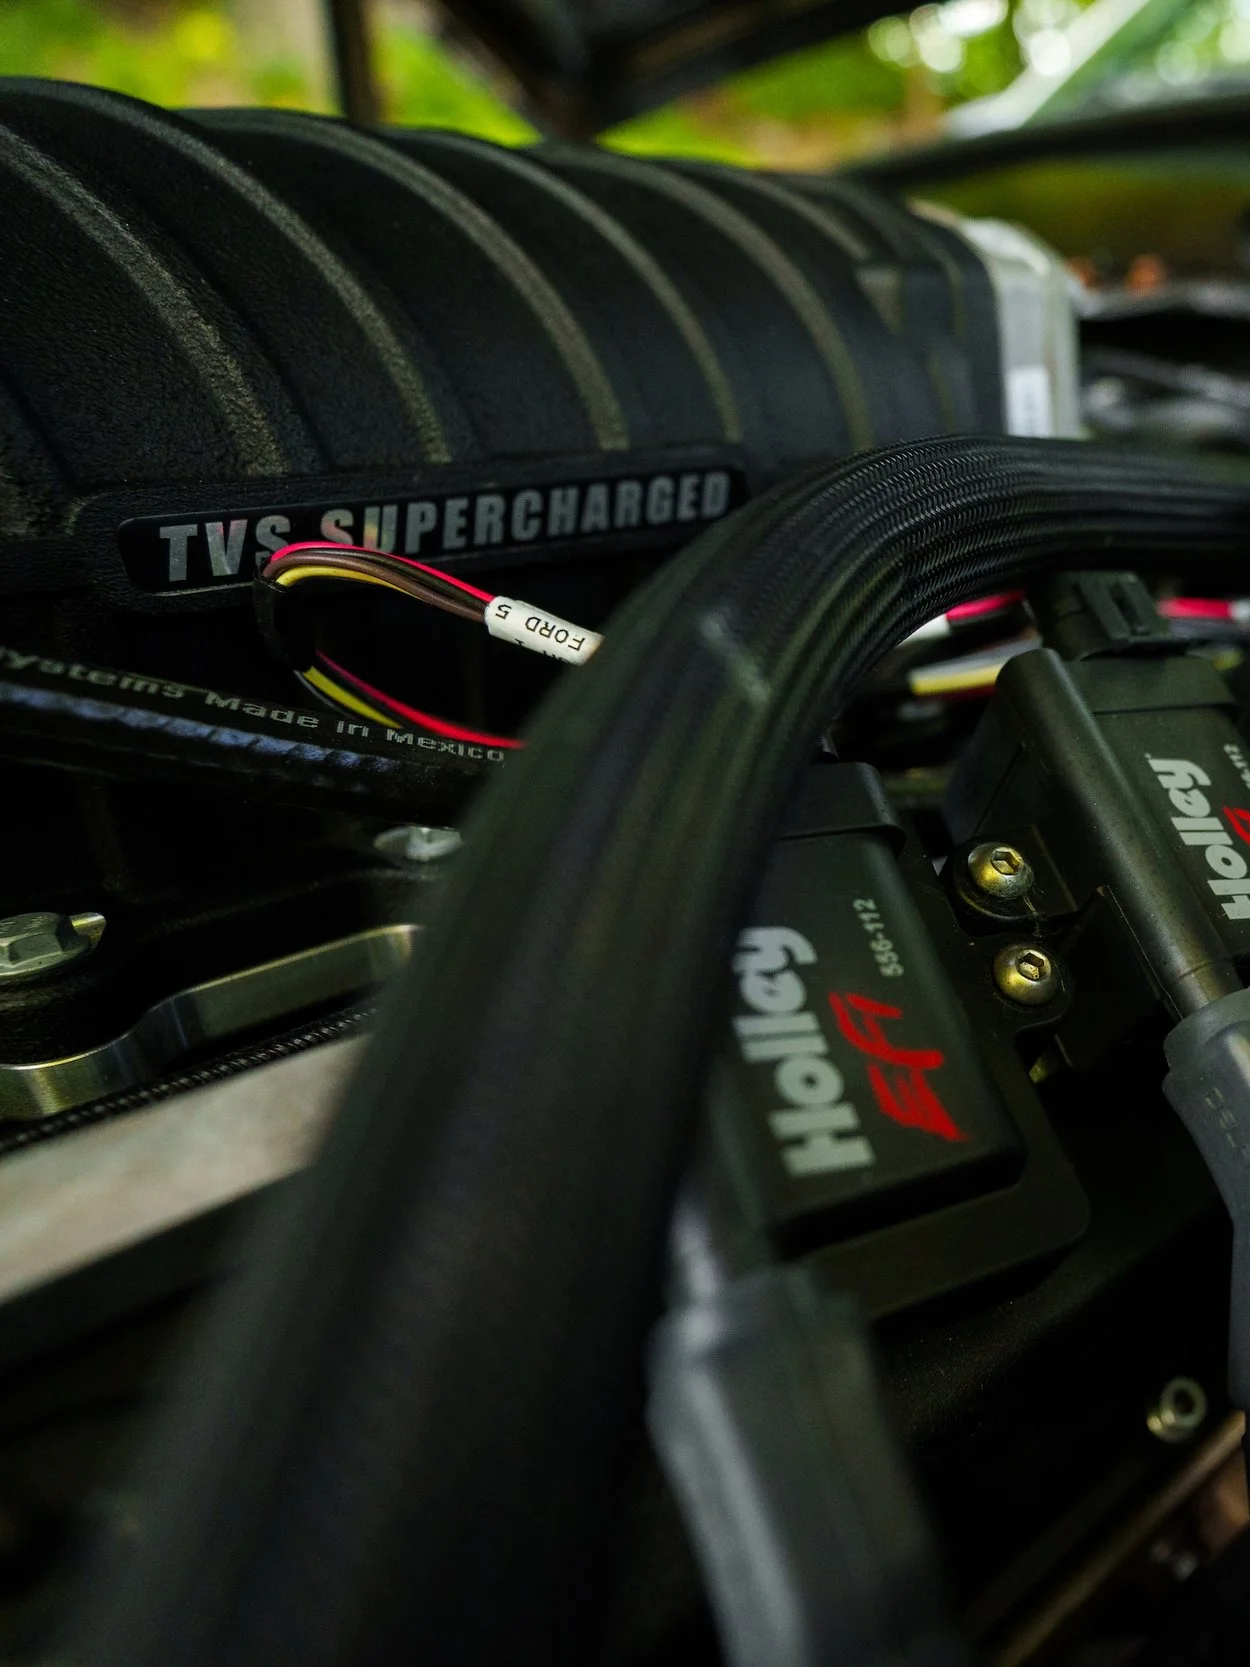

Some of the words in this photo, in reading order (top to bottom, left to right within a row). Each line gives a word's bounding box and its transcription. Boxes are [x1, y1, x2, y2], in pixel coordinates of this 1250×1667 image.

[159, 514, 293, 583] TVS
[319, 470, 732, 557] SUPERCHARGED
[494, 603, 513, 620] 5
[524, 615, 586, 651] FORD
[204, 690, 319, 728] Made
[386, 726, 505, 763] Mexico
[852, 897, 905, 978] 556-112
[731, 925, 877, 1180] Holley
[827, 990, 970, 1143] EFI
